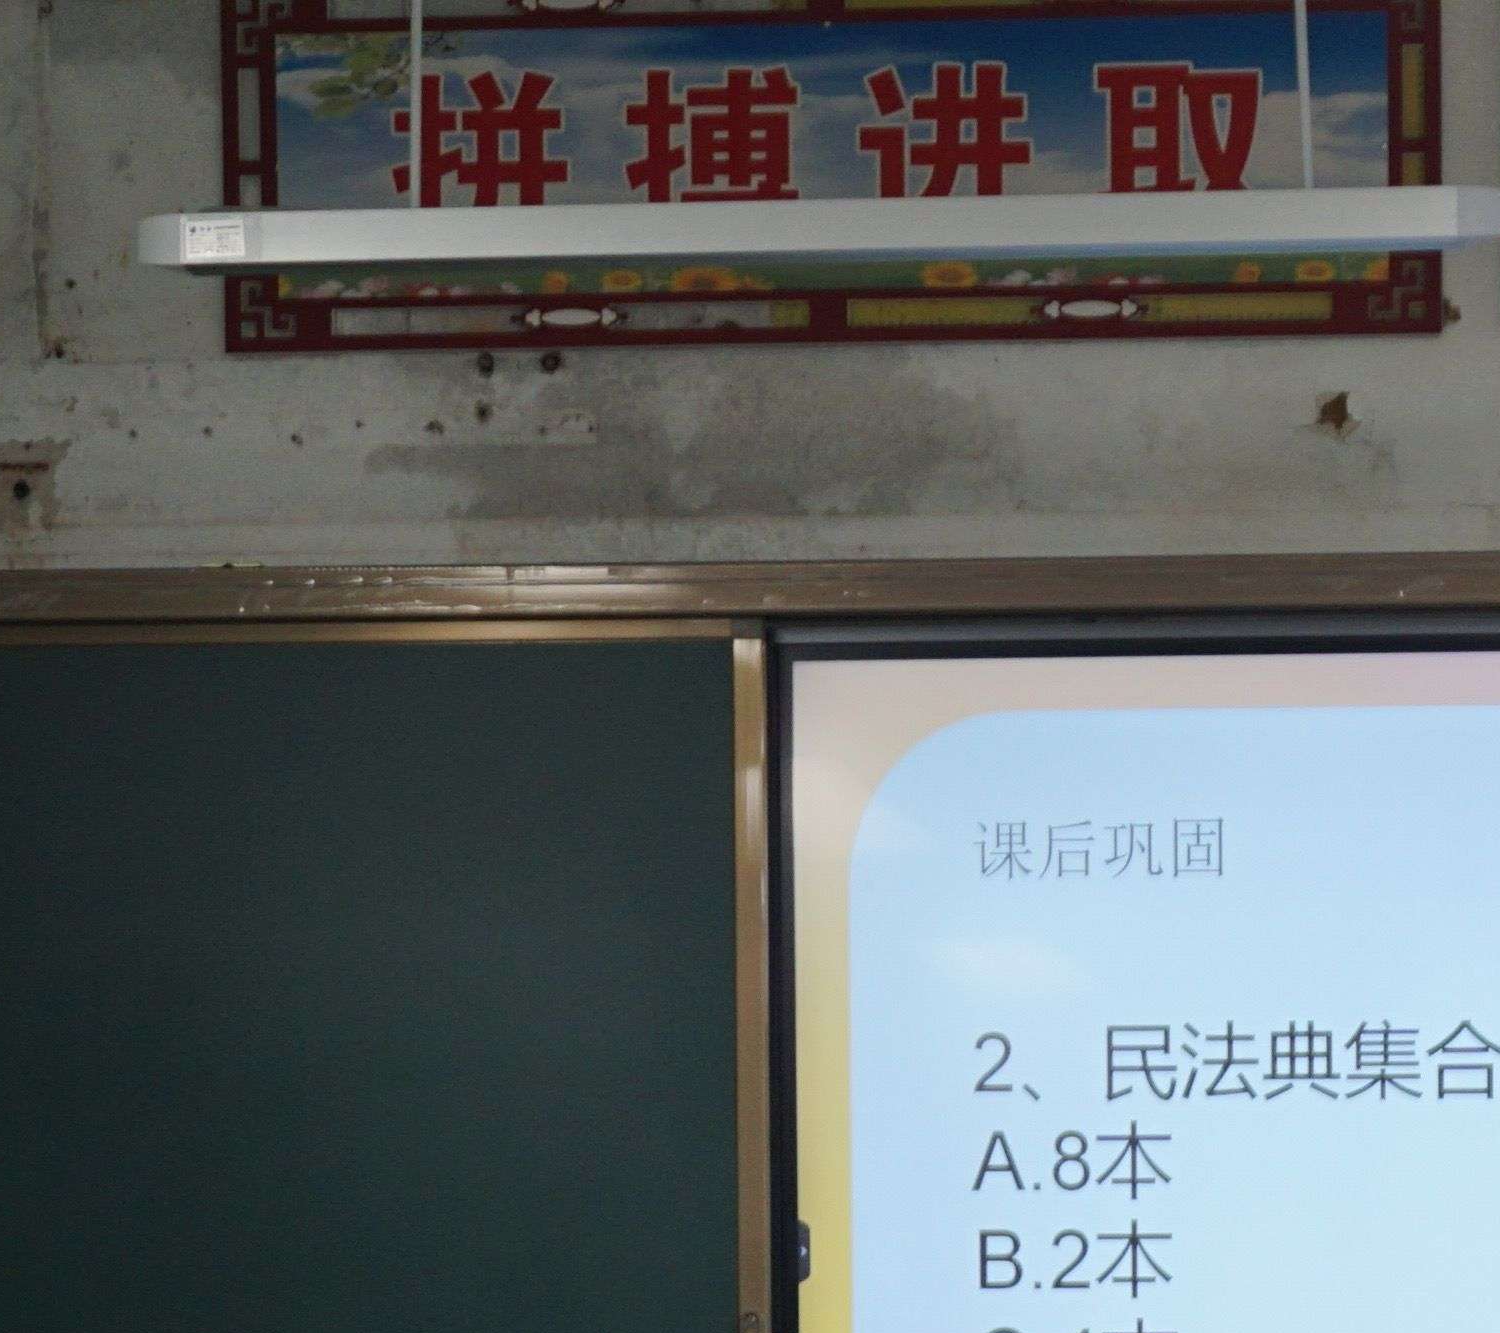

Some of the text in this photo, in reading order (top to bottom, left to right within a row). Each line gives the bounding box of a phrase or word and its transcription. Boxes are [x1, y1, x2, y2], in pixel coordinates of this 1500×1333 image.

[391, 62, 1265, 208] 拼搏进取
[972, 816, 1228, 880] 课后巩固
[971, 1120, 1174, 1199] A.8本
[978, 1218, 1175, 1298] B.2本
